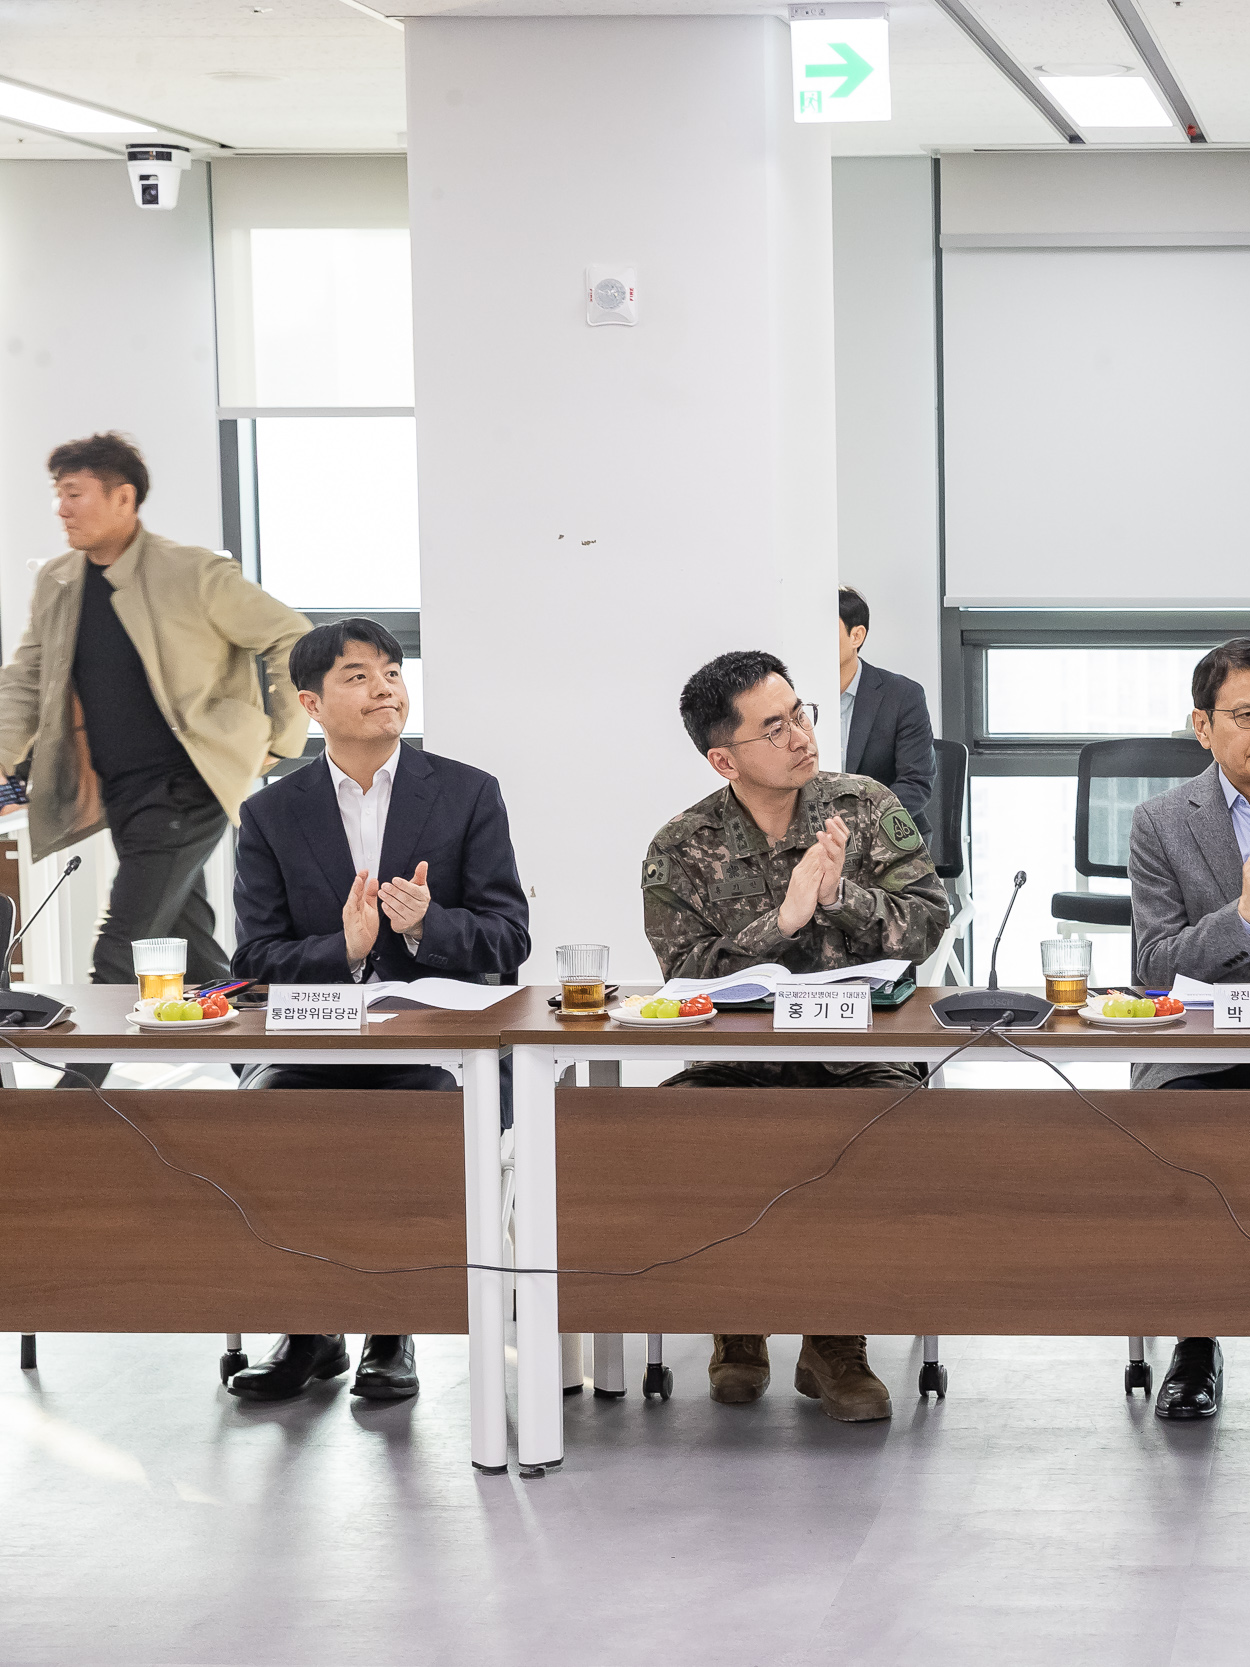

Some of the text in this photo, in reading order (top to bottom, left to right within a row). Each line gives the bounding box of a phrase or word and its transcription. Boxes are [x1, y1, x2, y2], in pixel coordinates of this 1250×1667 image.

[291, 992, 341, 1003] 국가정보원
[842, 991, 867, 1000] 1대대장
[271, 1007, 358, 1020] 통합방위담당관
